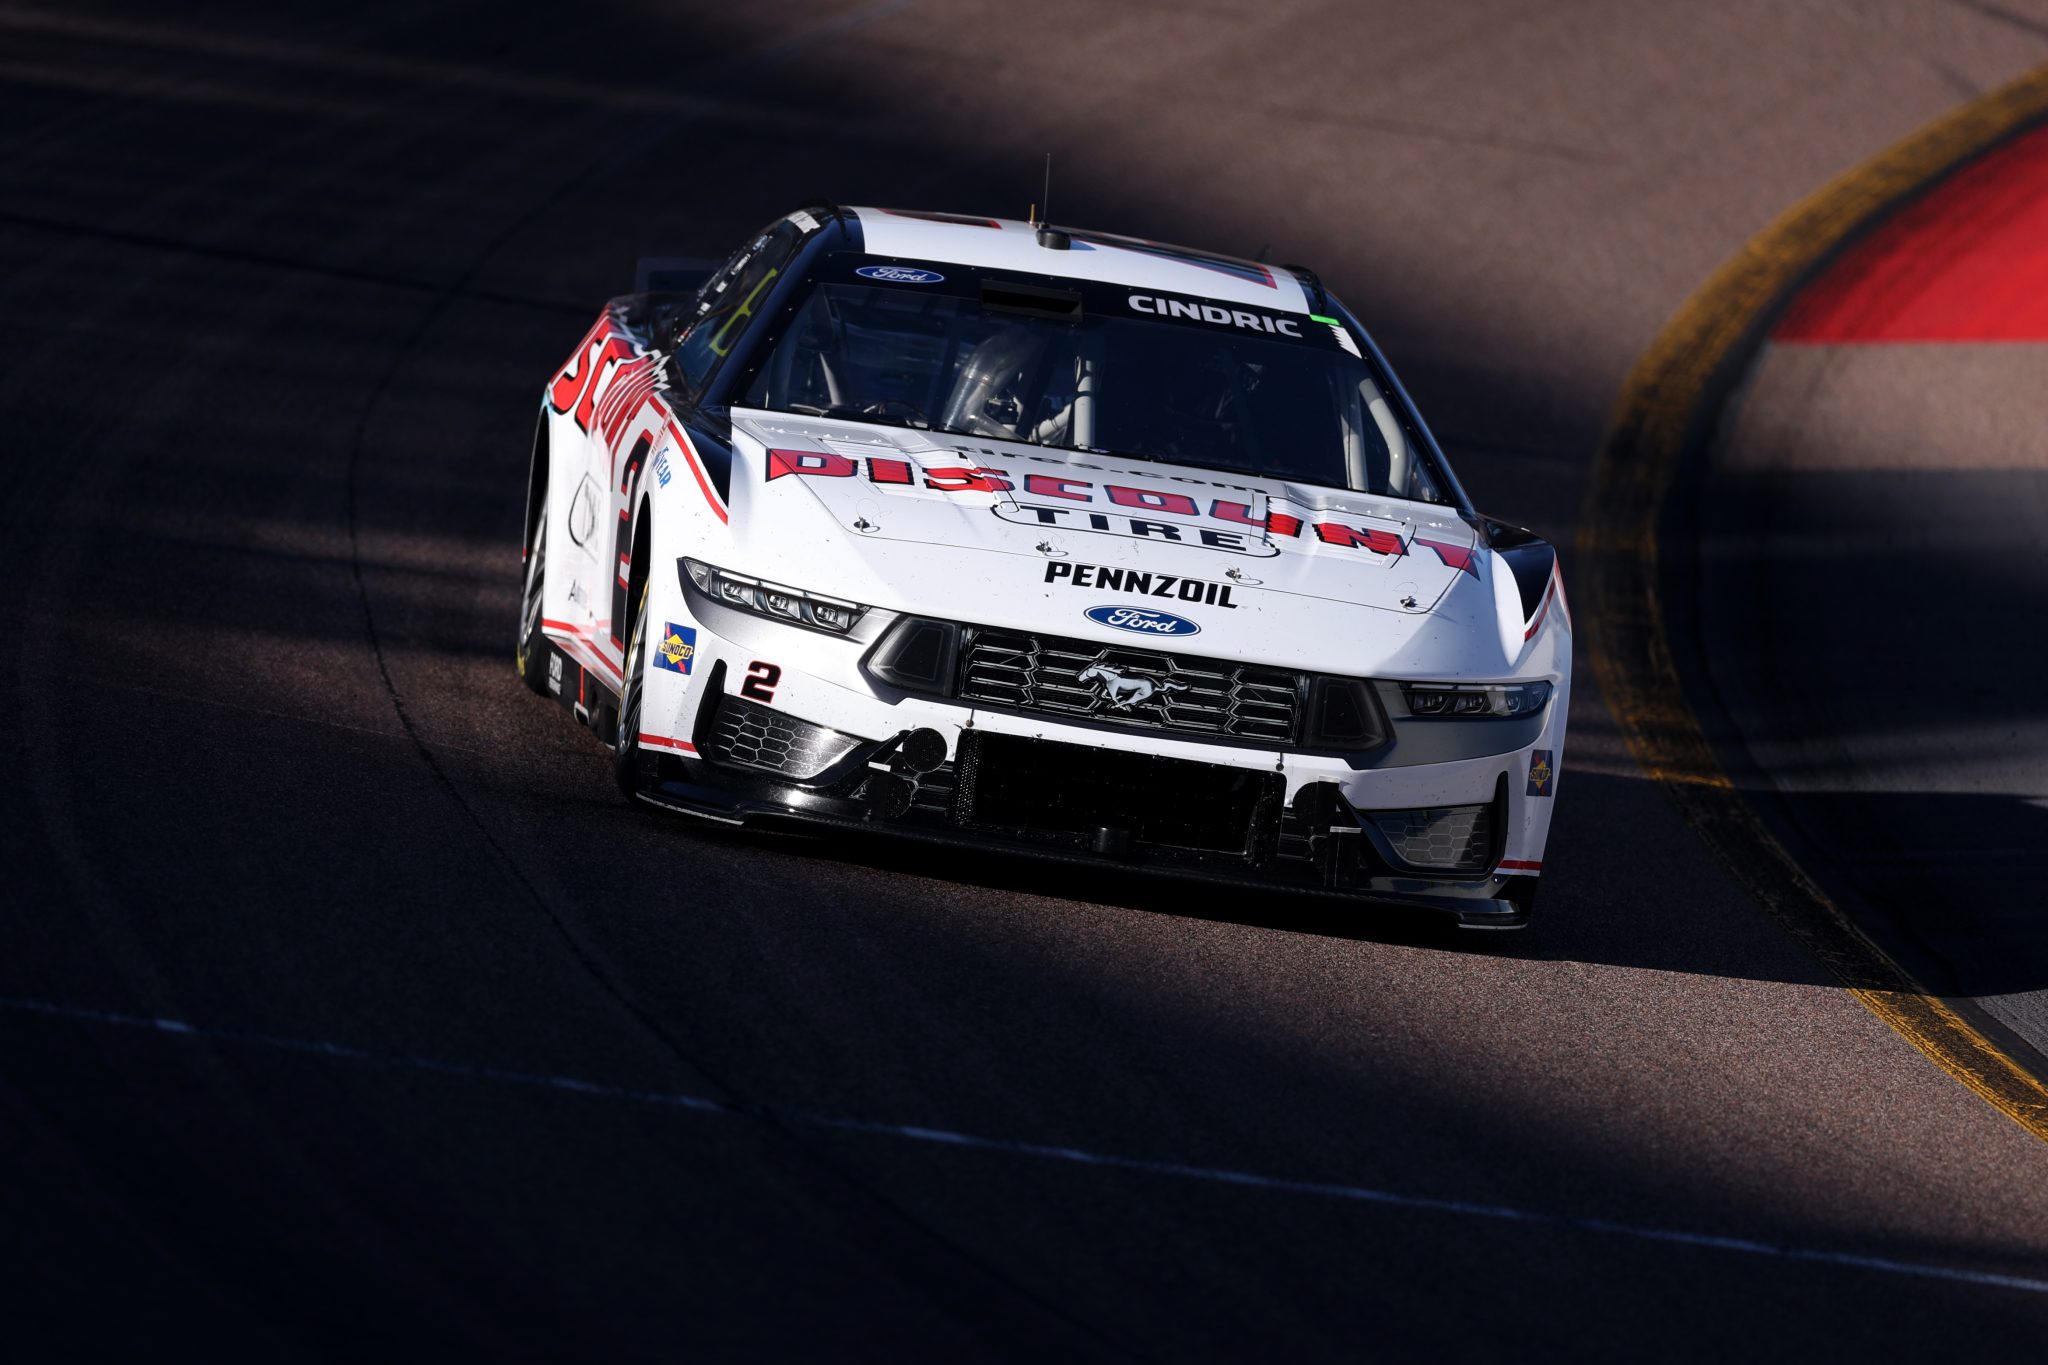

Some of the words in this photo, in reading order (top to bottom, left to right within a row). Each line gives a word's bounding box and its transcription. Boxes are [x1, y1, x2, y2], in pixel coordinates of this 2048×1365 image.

[872, 267, 929, 282] Ford
[1128, 294, 1303, 338] CINDRIC
[766, 448, 1481, 582] DISCOUNT
[1020, 505, 1247, 551] TIRE
[1044, 560, 1238, 609] PENNZOIL
[1107, 608, 1179, 633] Ford
[662, 641, 692, 658] SUNOCO
[740, 660, 782, 704] 2
